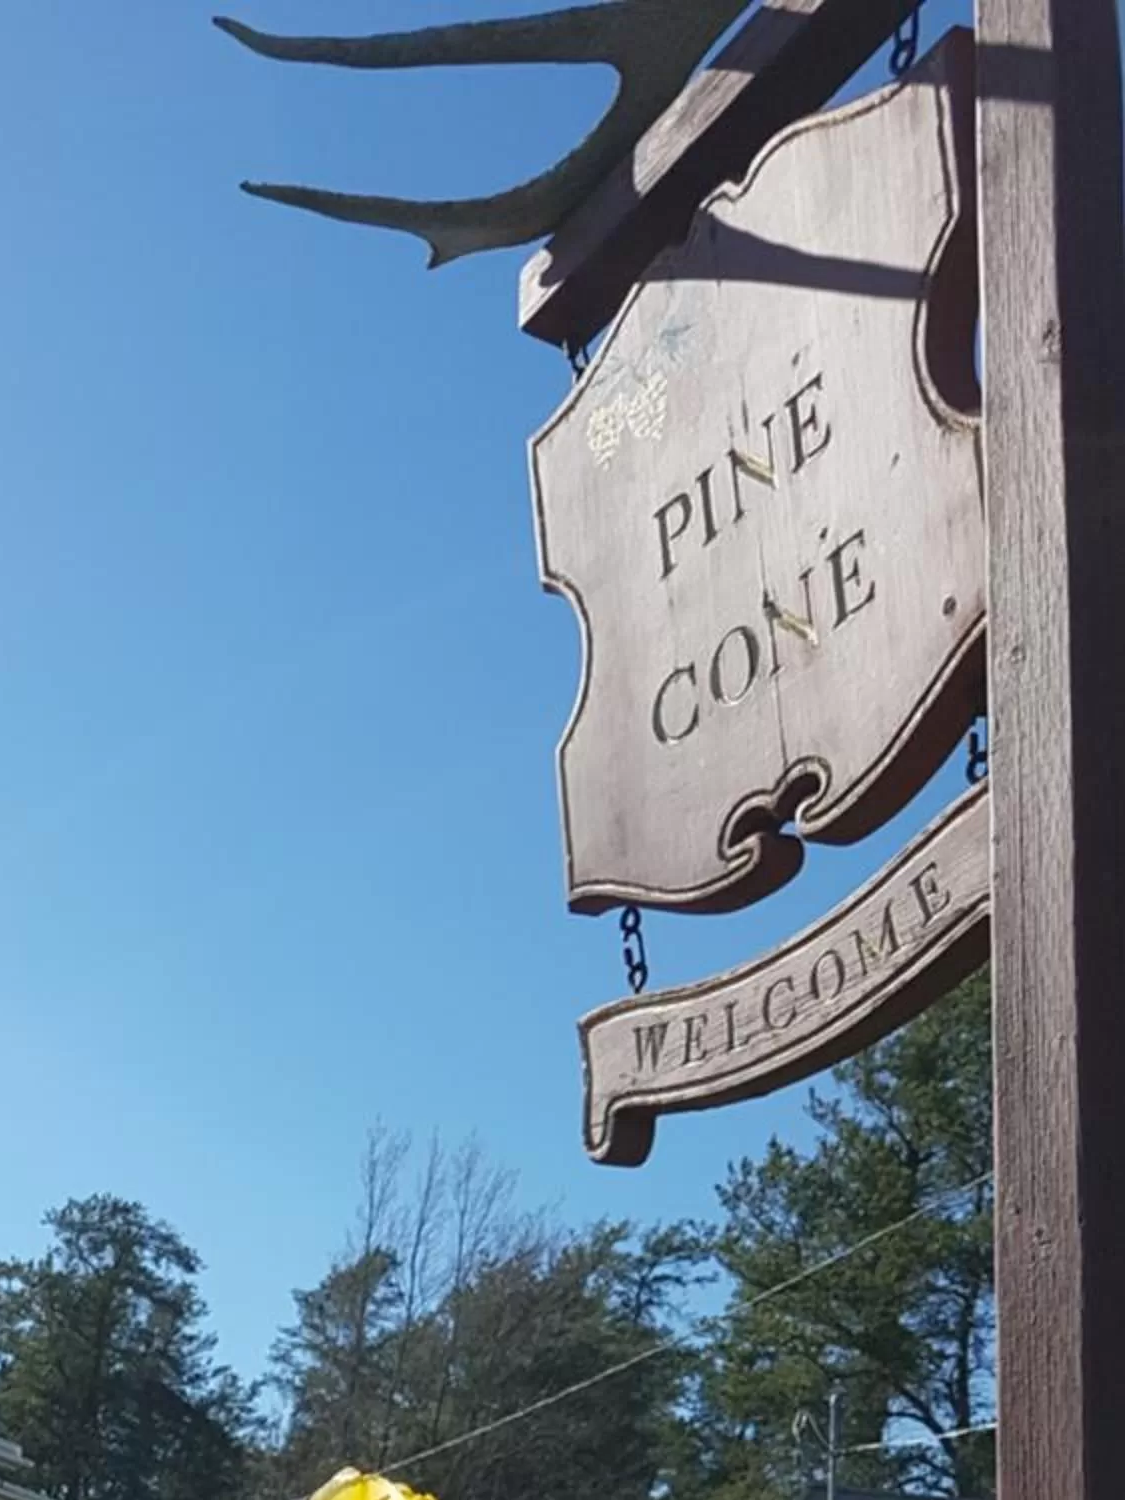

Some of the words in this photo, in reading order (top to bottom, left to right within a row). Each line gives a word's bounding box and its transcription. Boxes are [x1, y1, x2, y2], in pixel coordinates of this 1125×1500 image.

[652, 371, 832, 581] PINE
[651, 528, 876, 745] CONE
[632, 861, 953, 1074] WELCOME
